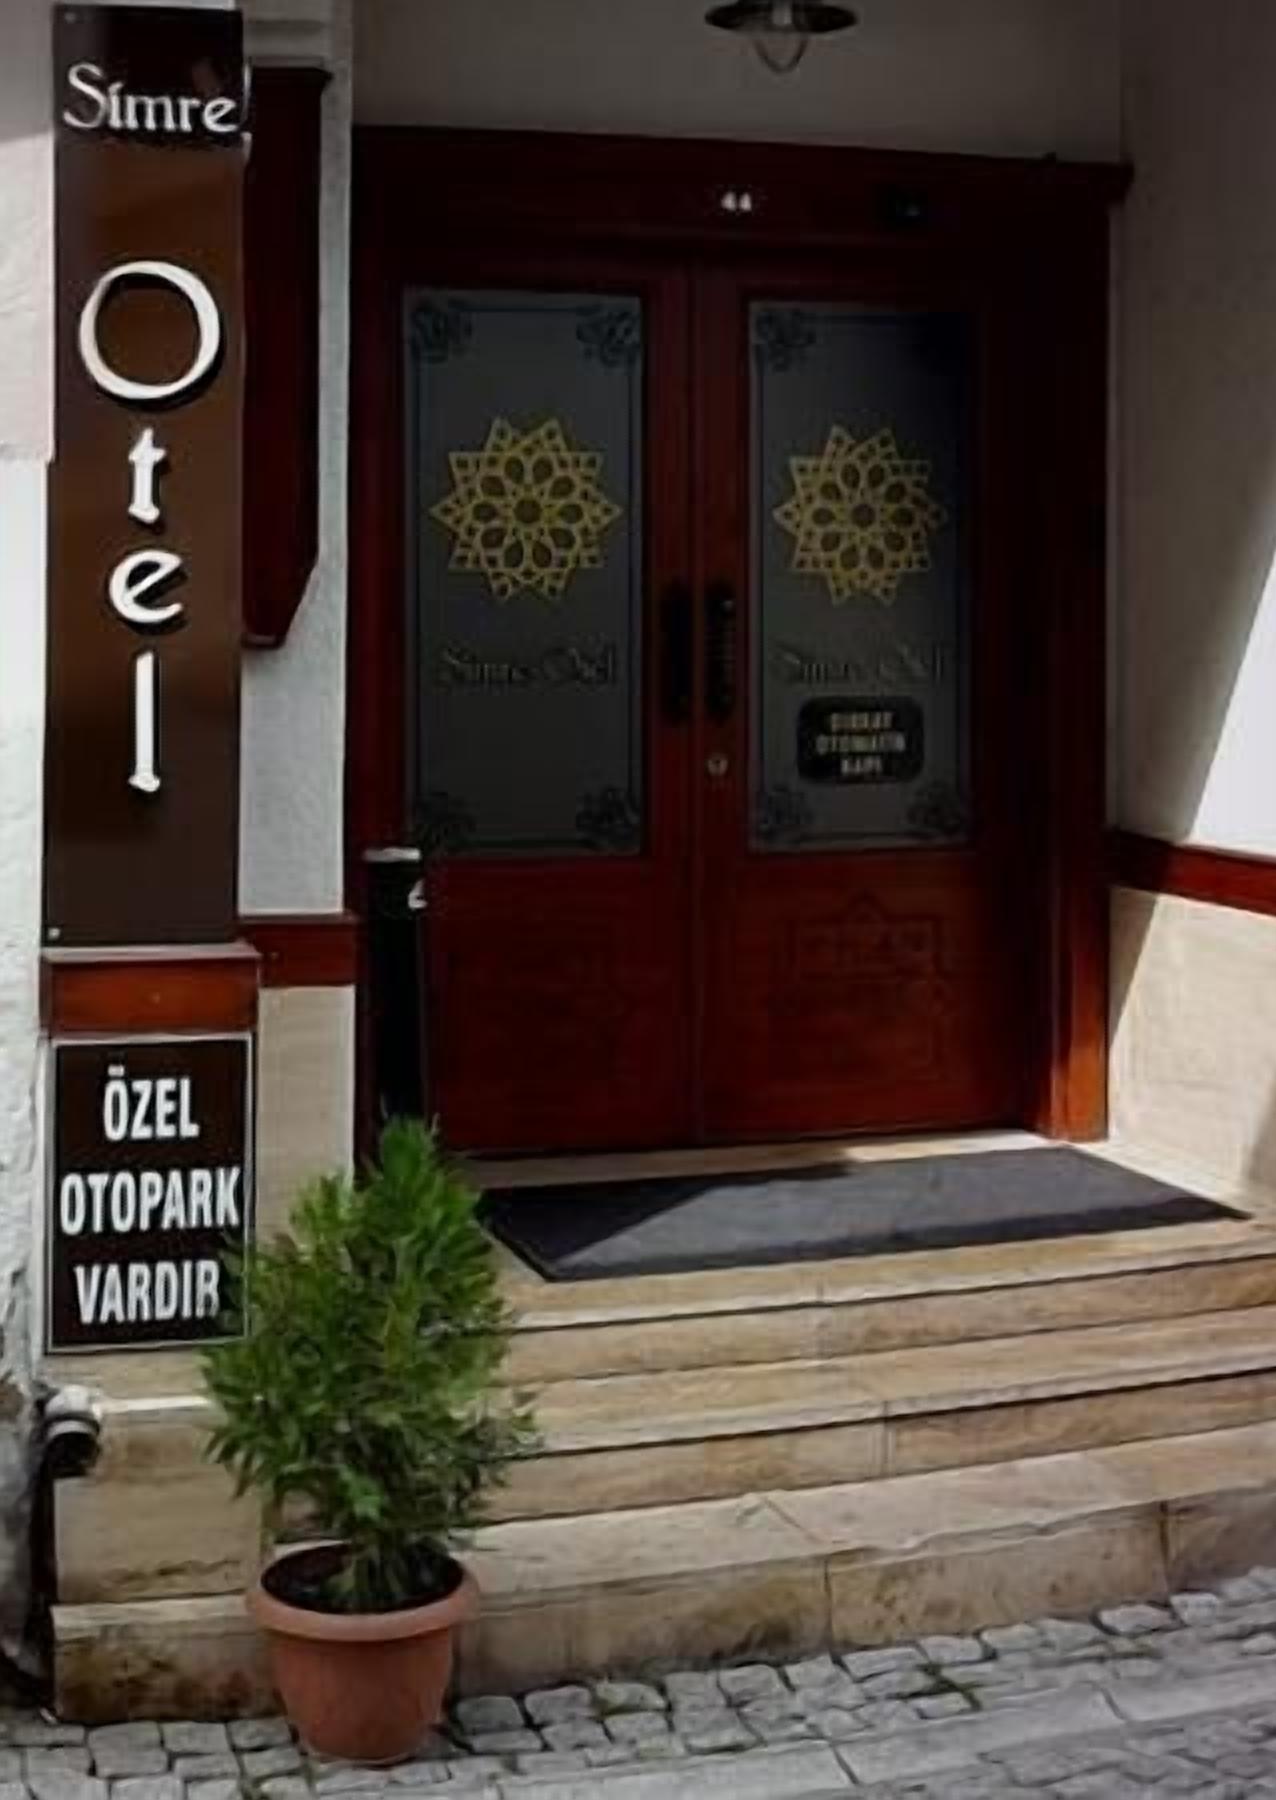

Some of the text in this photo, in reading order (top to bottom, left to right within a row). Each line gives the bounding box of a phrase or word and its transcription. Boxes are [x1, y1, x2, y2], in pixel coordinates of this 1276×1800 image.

[79, 260, 221, 793] Otel
[103, 1065, 200, 1142] ÖZEL
[59, 1166, 241, 1236] OTOPARK
[73, 1259, 221, 1325] VARDIR
